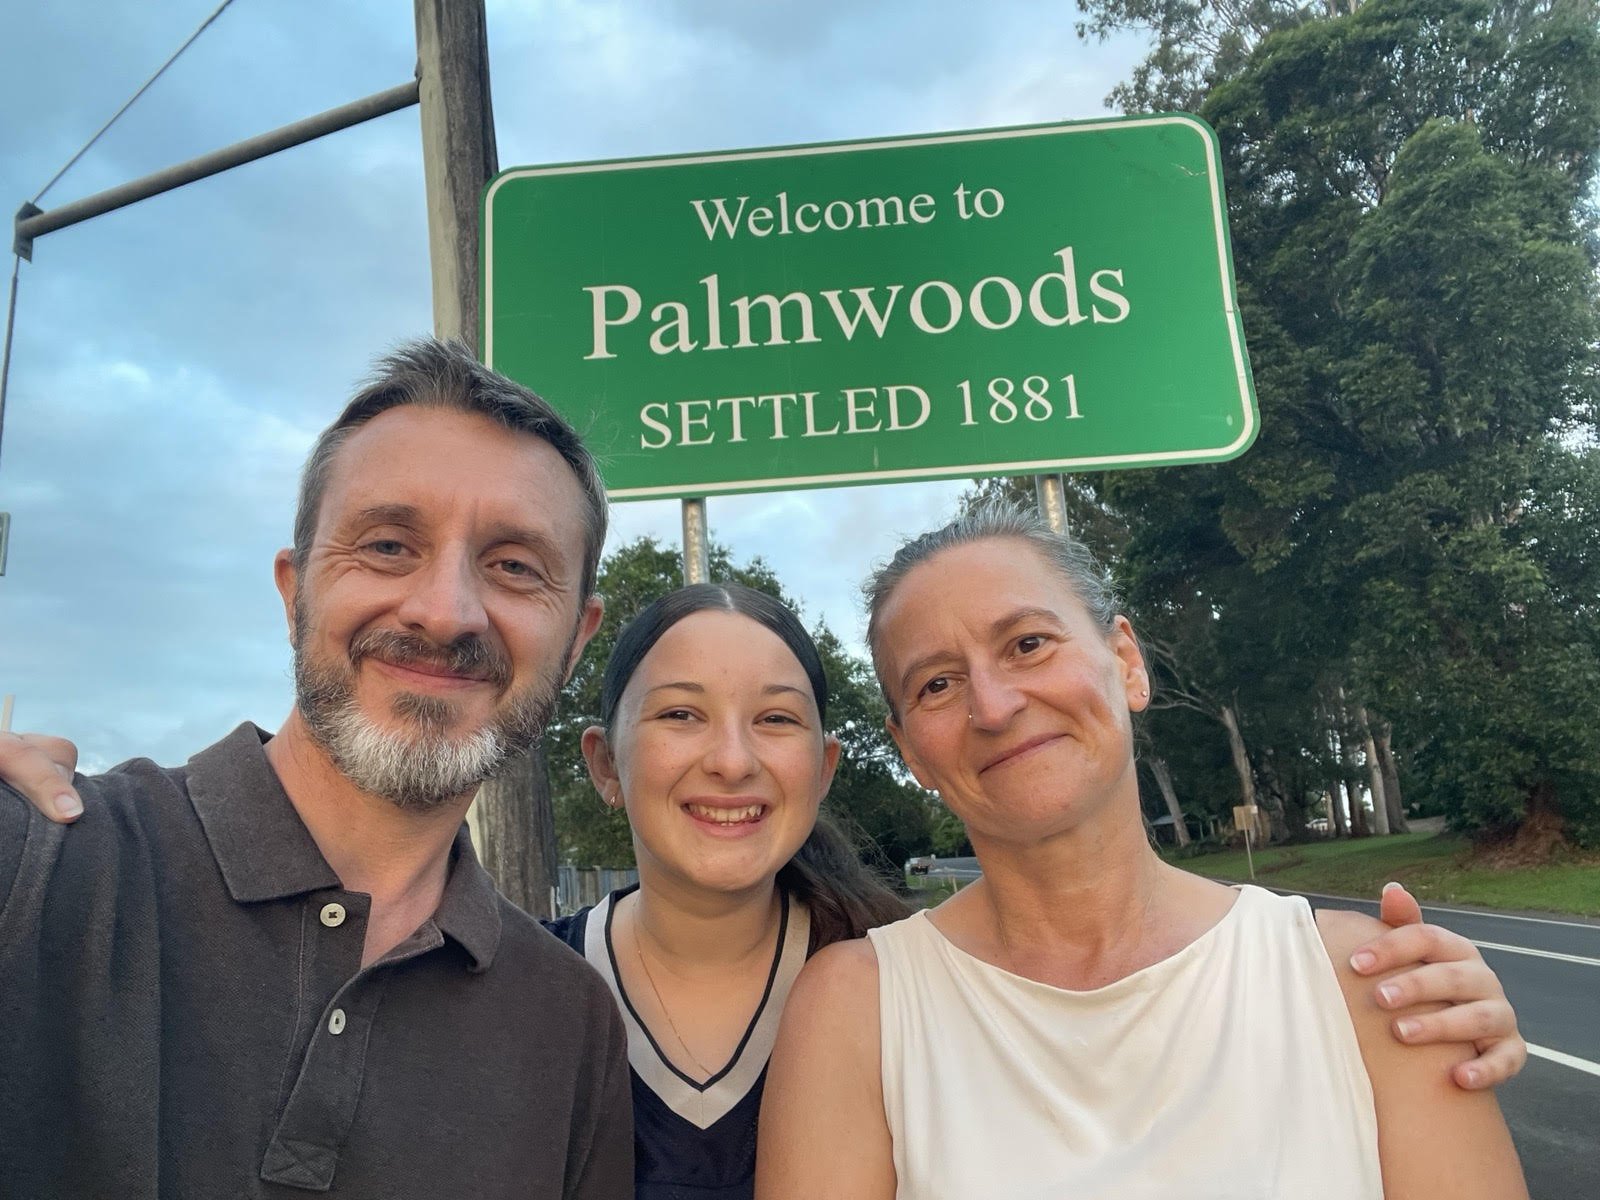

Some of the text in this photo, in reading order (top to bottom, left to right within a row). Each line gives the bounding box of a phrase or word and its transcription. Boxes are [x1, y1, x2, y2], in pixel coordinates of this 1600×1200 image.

[691, 183, 1005, 241] Welcome to
[582, 246, 1131, 361] Palmwoods
[639, 374, 1084, 450] SETTLED 1881
